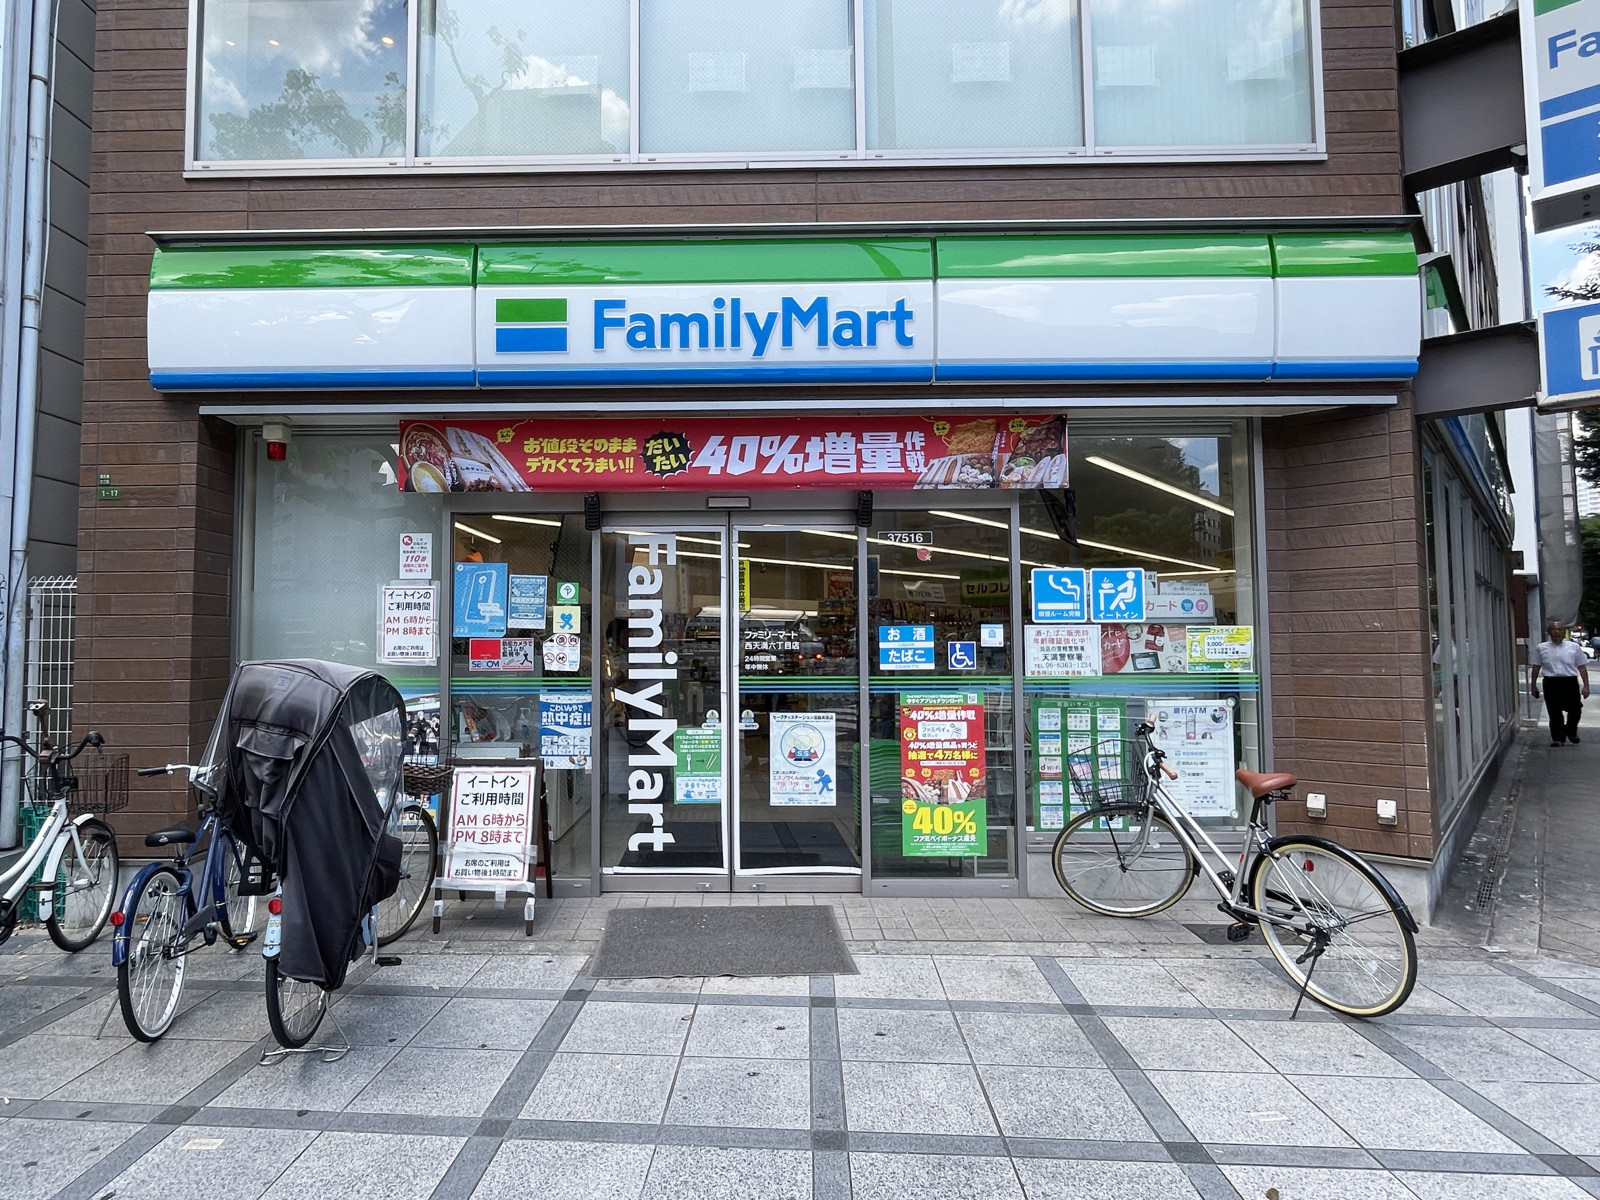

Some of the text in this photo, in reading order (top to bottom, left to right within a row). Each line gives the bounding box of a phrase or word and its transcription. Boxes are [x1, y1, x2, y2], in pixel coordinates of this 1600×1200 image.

[593, 296, 914, 358] FamilyMart
[523, 437, 638, 454] お値段そのまま
[887, 533, 924, 543] 37516
[388, 590, 431, 599] イートインの
[388, 602, 431, 611] ご利用時間
[386, 615, 431, 625] AM 6時から
[386, 627, 400, 635] PM
[744, 631, 798, 639] ファミリーマート
[744, 641, 800, 650] 西天満六丁目店
[888, 650, 926, 662] たばこ
[1042, 653, 1083, 661] 天満警察署
[471, 660, 500, 668] SECOM
[614, 534, 677, 851] FamilyMart
[467, 775, 520, 788] イートイン
[461, 792, 524, 806] ご利用時間
[456, 813, 525, 826] AM 6時から
[912, 806, 977, 835] 40%
[455, 829, 524, 843] PM 8時まで
[464, 859, 511, 867] お席のご利用は
